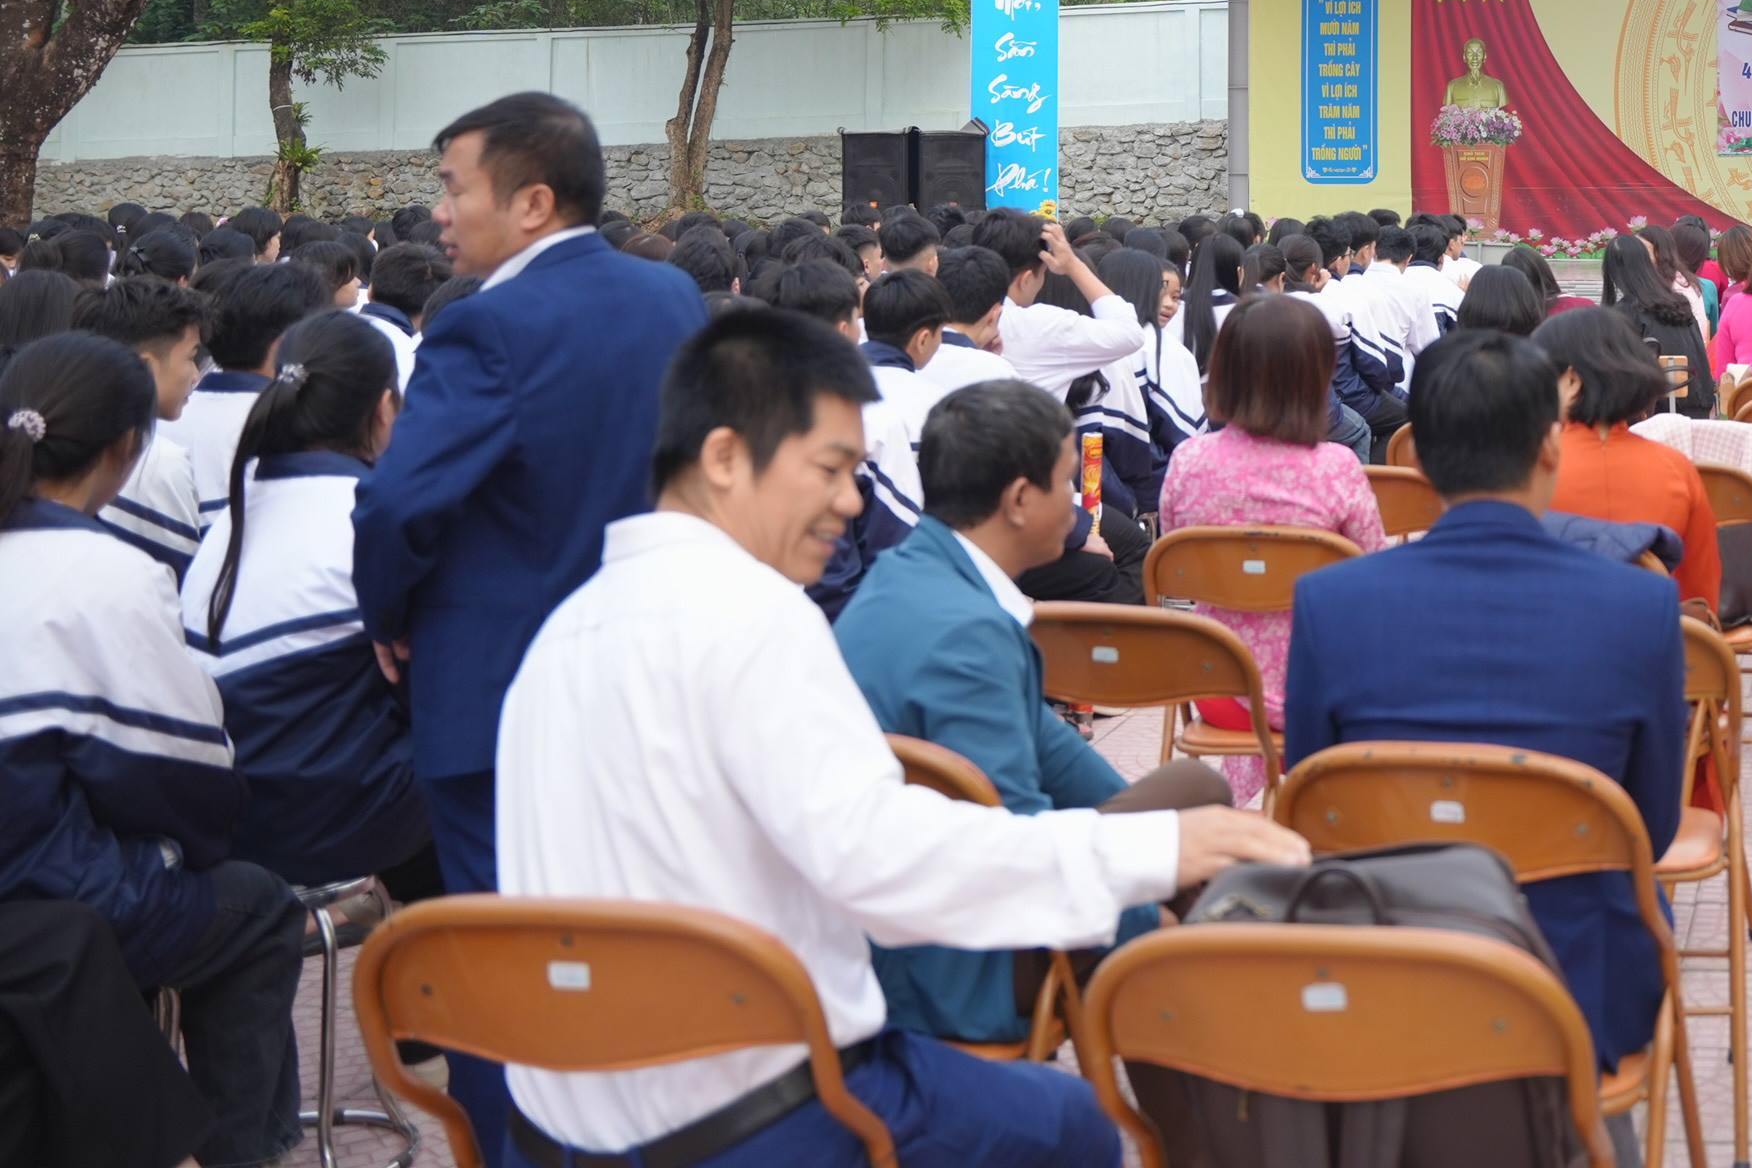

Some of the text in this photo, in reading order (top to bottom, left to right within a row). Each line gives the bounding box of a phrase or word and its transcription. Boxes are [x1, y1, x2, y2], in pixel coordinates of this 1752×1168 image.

[994, 32, 1037, 62] Sẵn
[988, 73, 1051, 114] Sàng
[990, 119, 1046, 152] Bứt
[985, 163, 1051, 197] Phá!
